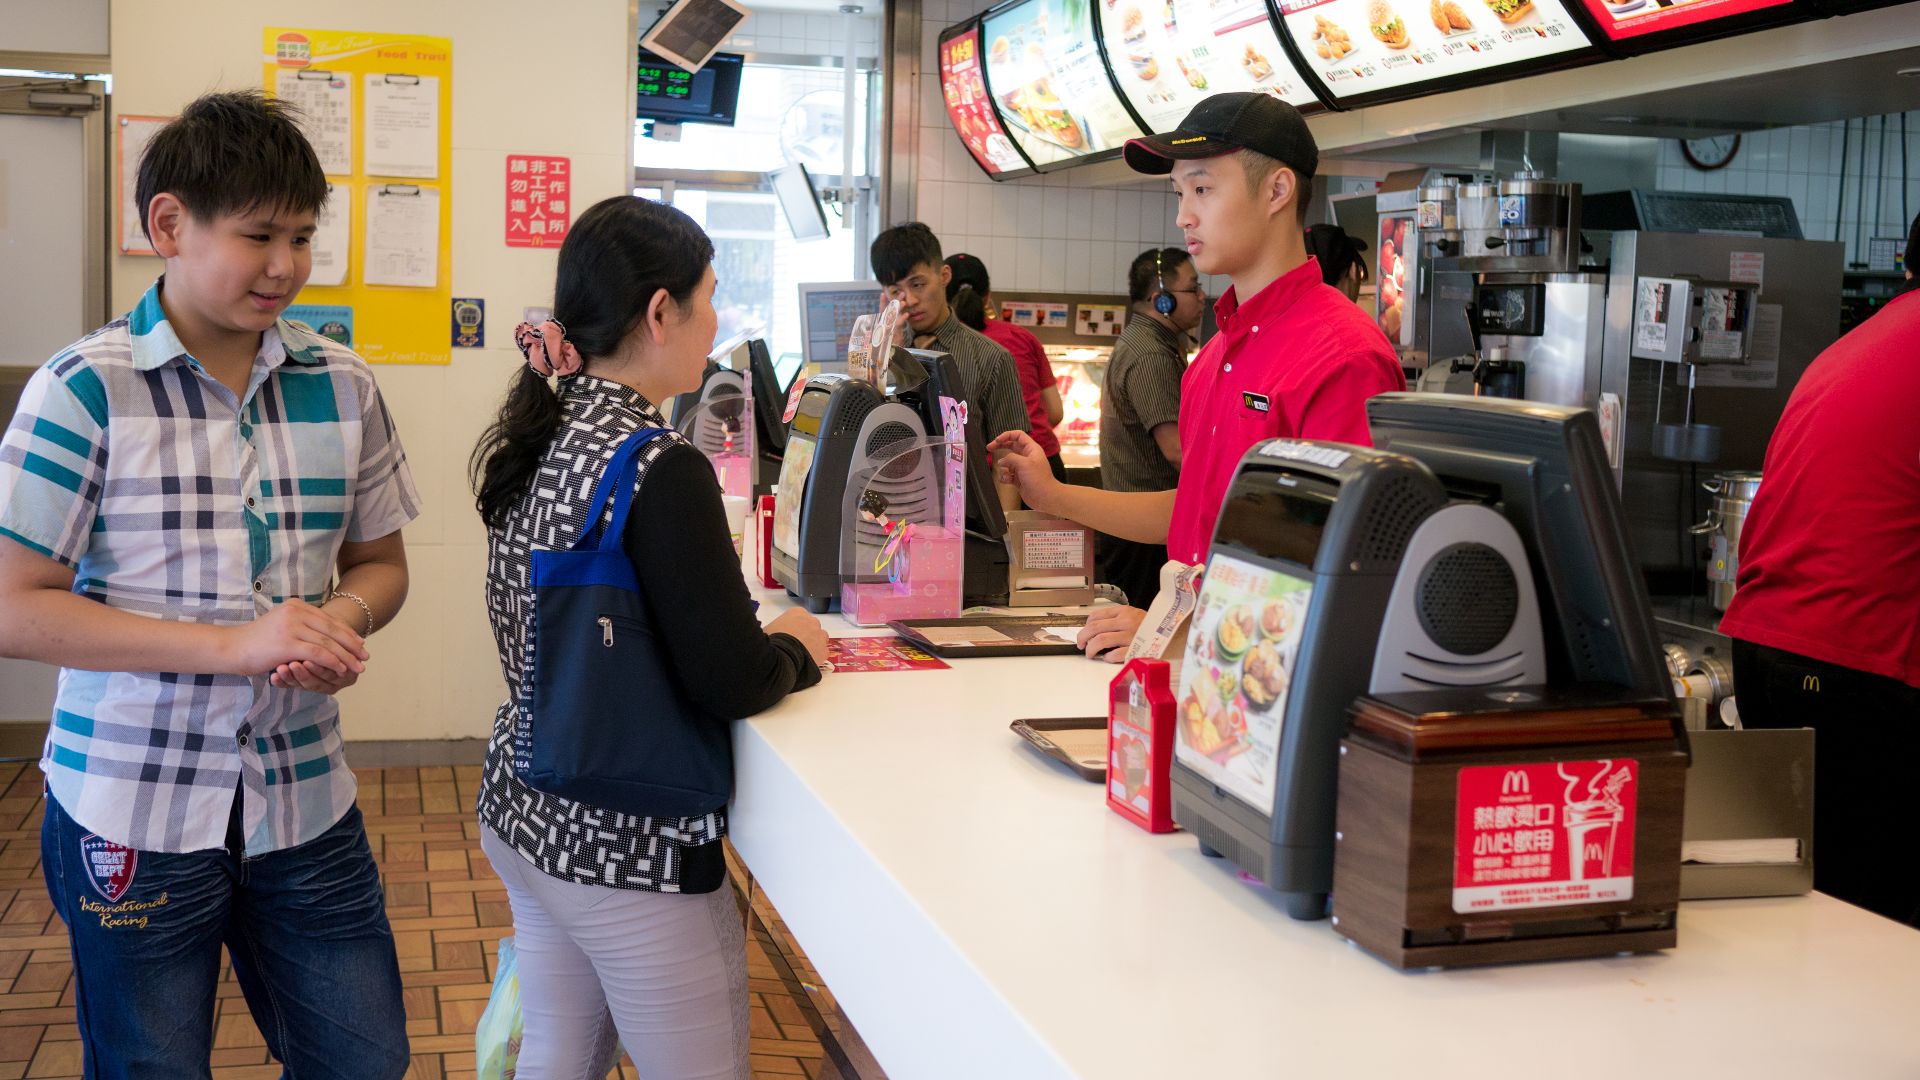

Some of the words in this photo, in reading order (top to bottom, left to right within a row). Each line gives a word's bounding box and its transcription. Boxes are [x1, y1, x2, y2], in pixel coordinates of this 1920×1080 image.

[377, 50, 408, 60] Food
[416, 52, 447, 62] Trust
[1171, 136, 1207, 145] McDonald's
[510, 159, 528, 232] 請勿進入
[529, 160, 548, 235] 非工作人員
[548, 161, 566, 233] 工作場所
[1474, 804, 1554, 830] 熱飲燙口
[1473, 829, 1554, 855] 小心飲用
[91, 851, 127, 865] GREAT
[95, 865, 125, 877] DEPT
[80, 891, 169, 912] International
[99, 913, 148, 928] Racing
